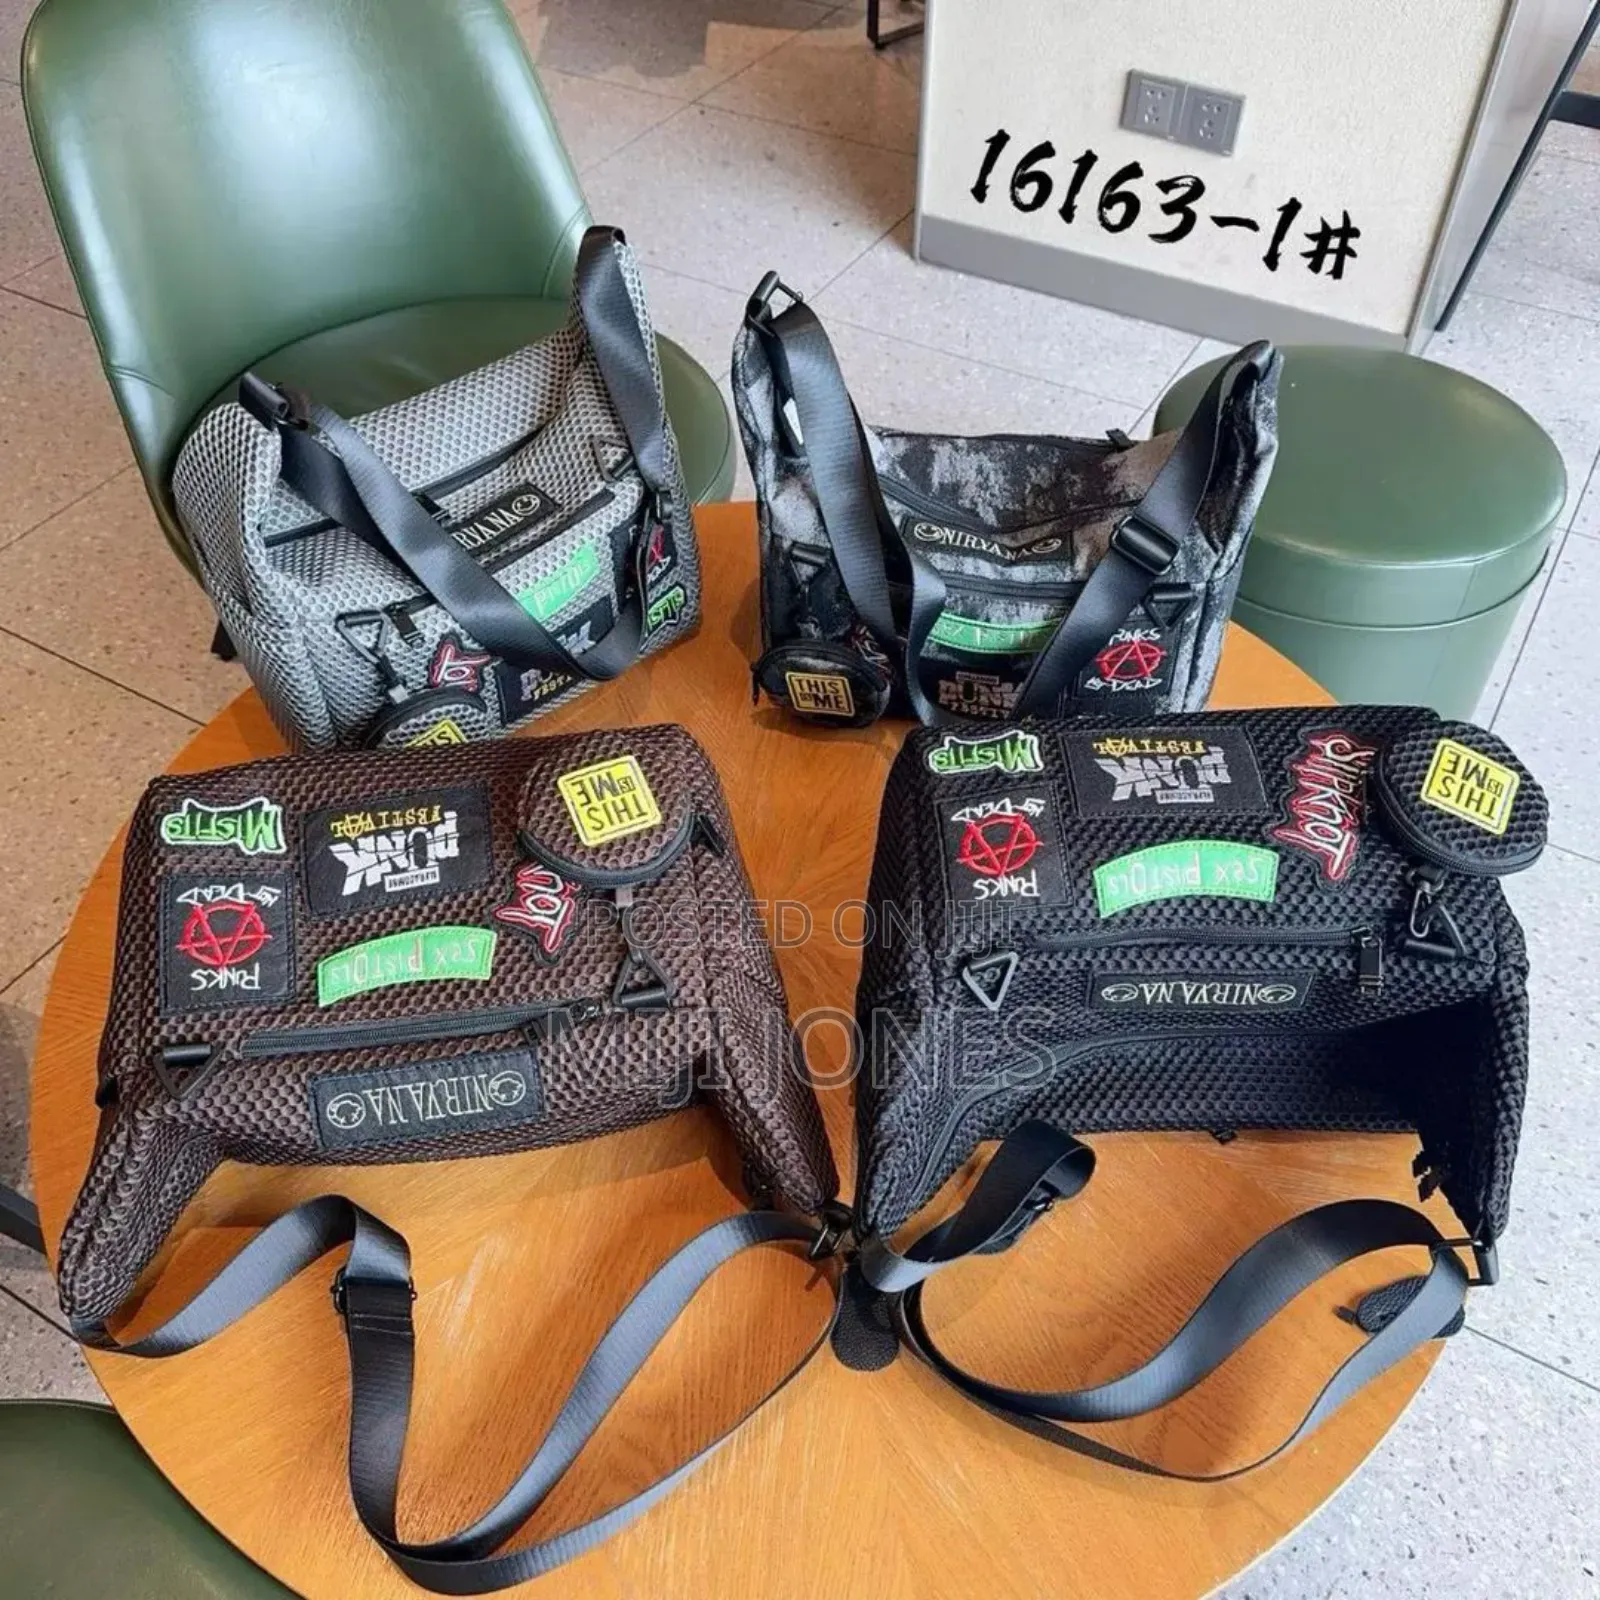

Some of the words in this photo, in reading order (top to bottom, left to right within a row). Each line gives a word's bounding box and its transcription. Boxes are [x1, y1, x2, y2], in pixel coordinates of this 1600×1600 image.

[452, 507, 524, 551] RVANA
[940, 526, 1033, 562] NIRVANA
[794, 679, 839, 695] THIS
[813, 693, 846, 709] ME
[1094, 746, 1232, 801] PUNK
[1446, 750, 1490, 790] ME
[572, 771, 620, 808] ME
[1438, 776, 1499, 820] THIS
[330, 805, 441, 839] FESTIVAL
[585, 794, 648, 831] THIS
[951, 797, 1013, 824] DEAD
[329, 811, 460, 896] PUNK
[176, 883, 245, 907] DEAD
[973, 868, 1041, 900] PUNKS
[190, 962, 262, 990] PUNKS
[1138, 981, 1262, 1006] NIRVANA
[362, 1073, 494, 1126] NIRVANA
